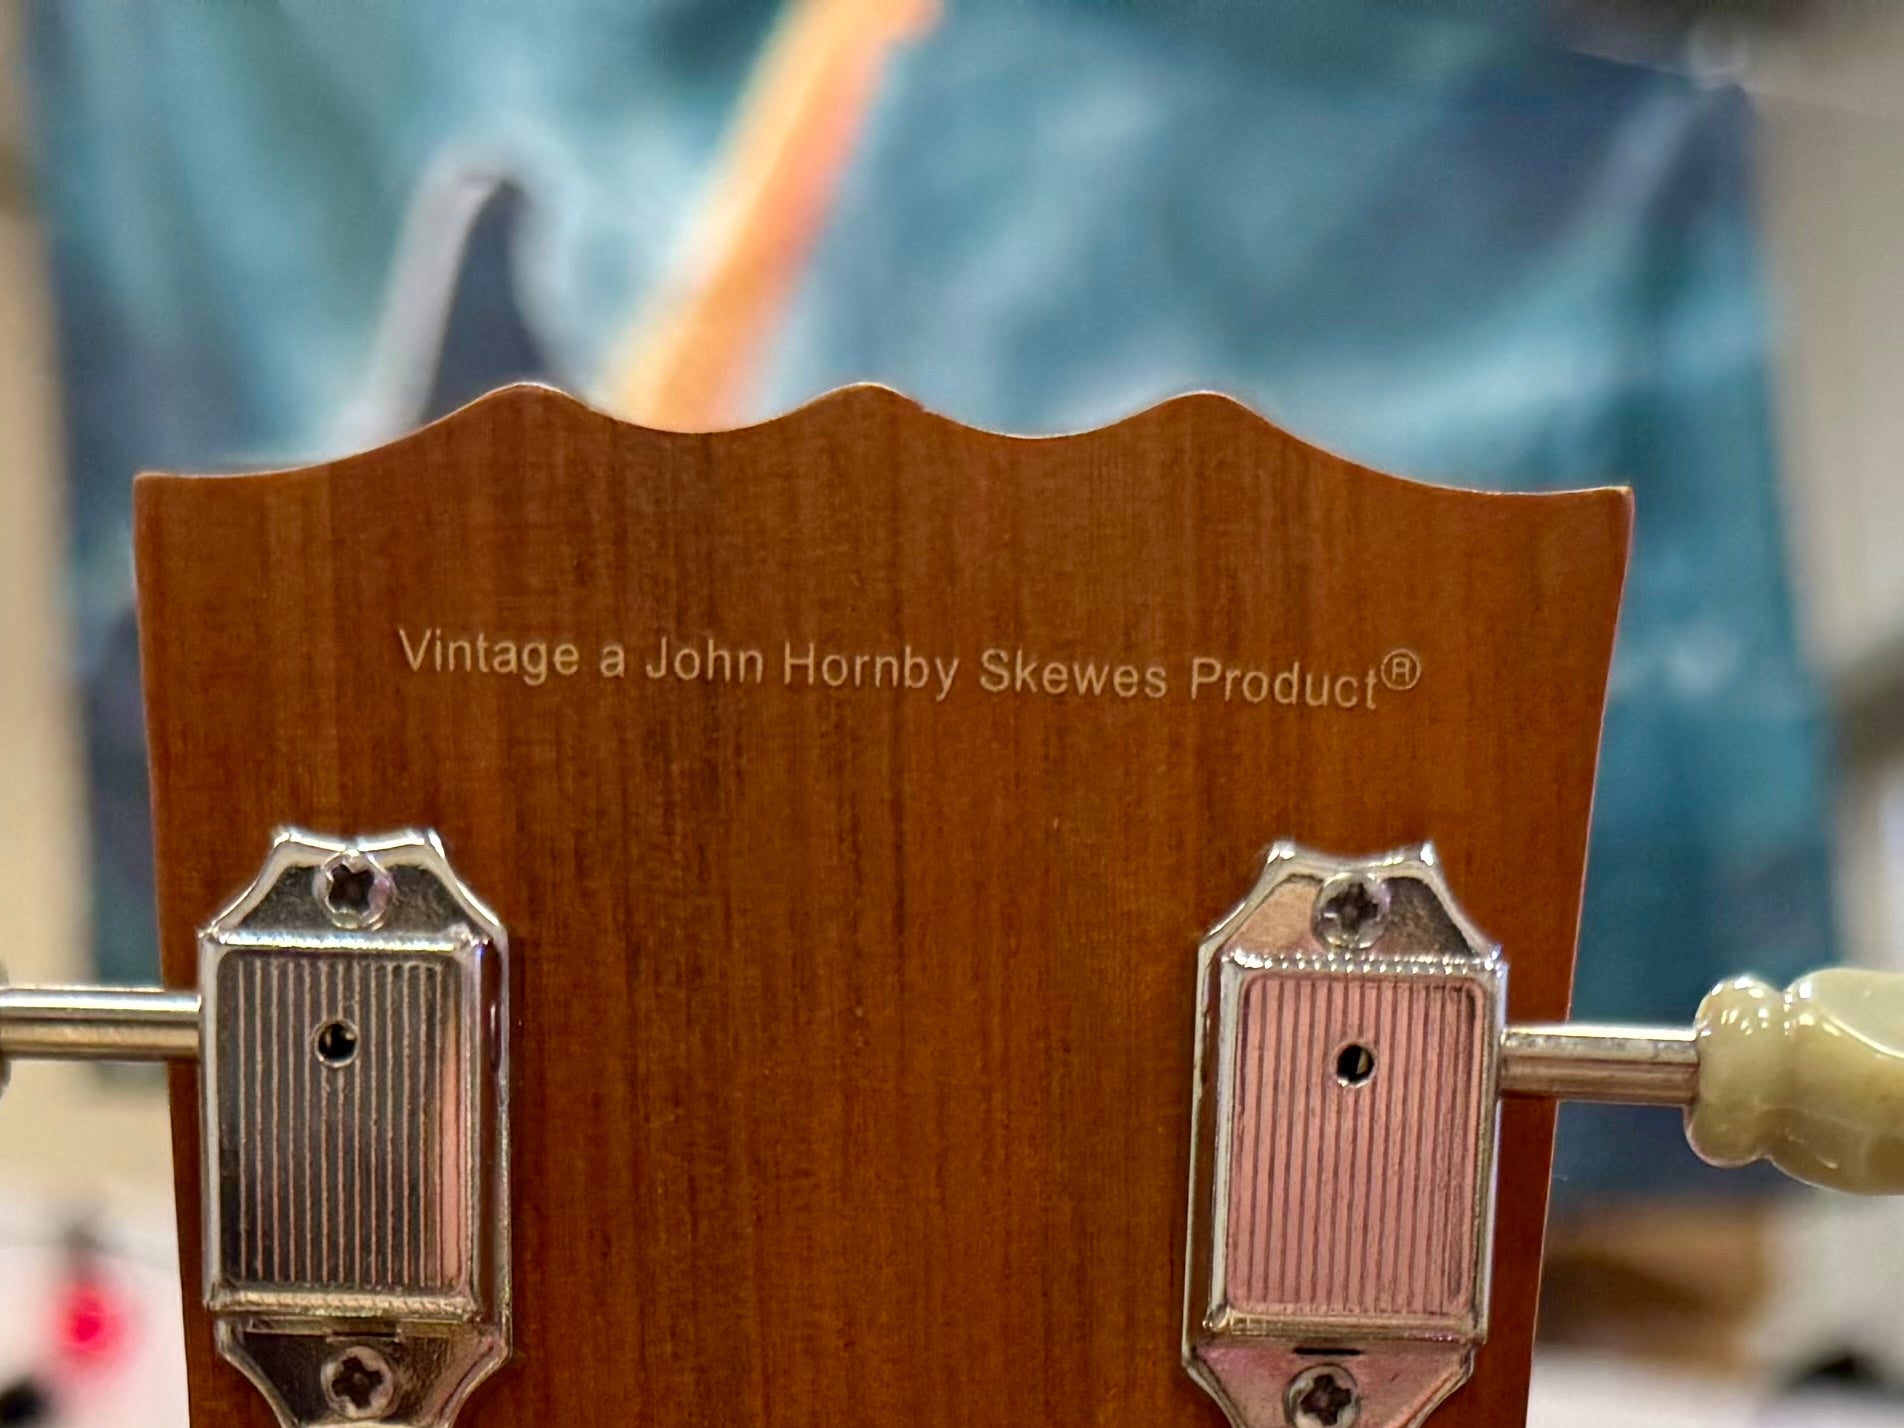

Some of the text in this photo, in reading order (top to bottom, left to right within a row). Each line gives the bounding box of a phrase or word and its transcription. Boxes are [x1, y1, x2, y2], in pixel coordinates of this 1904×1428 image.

[398, 627, 580, 687] Vintage
[599, 643, 625, 679] a
[645, 636, 764, 684] John
[783, 640, 960, 701] Hornby
[979, 647, 1168, 699] Skewes
